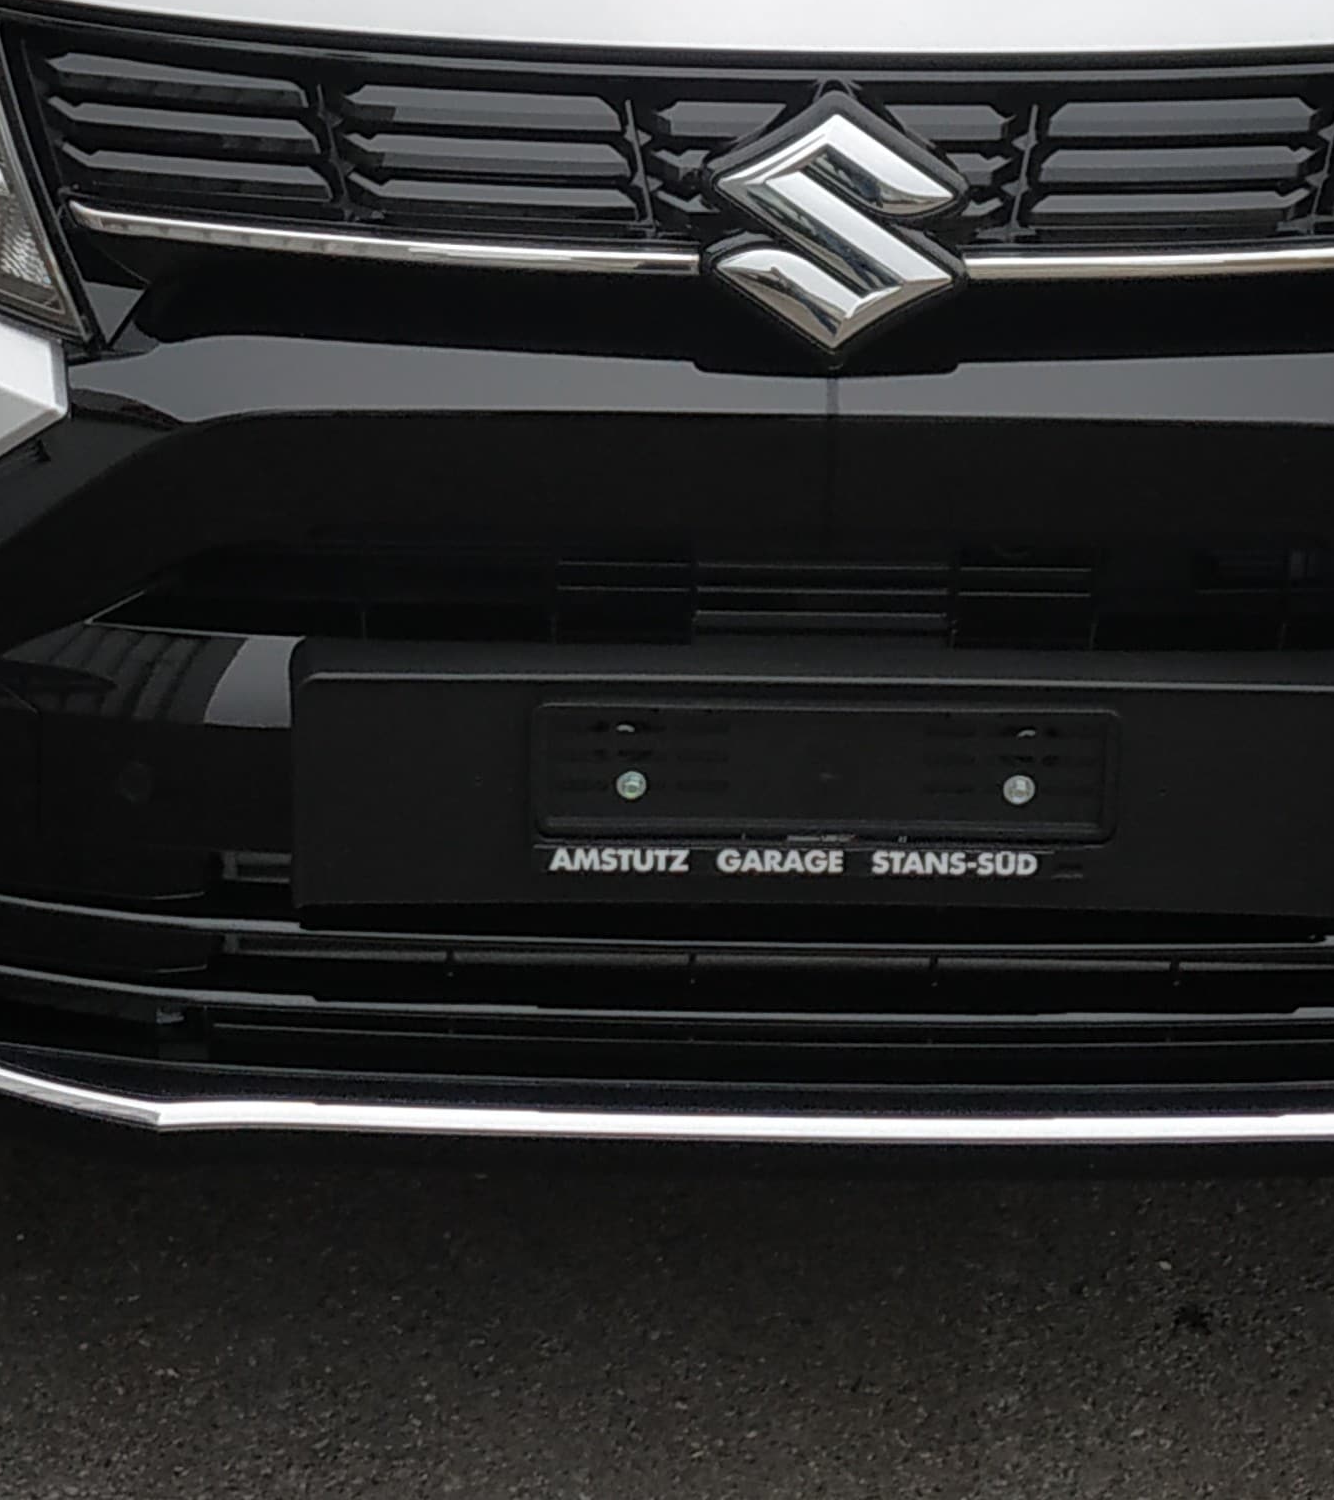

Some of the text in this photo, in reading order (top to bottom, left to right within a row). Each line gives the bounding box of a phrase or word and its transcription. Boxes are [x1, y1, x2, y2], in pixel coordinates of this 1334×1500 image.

[548, 848, 1038, 876] AMSTUTZ GARAGE STANS-SÜD
